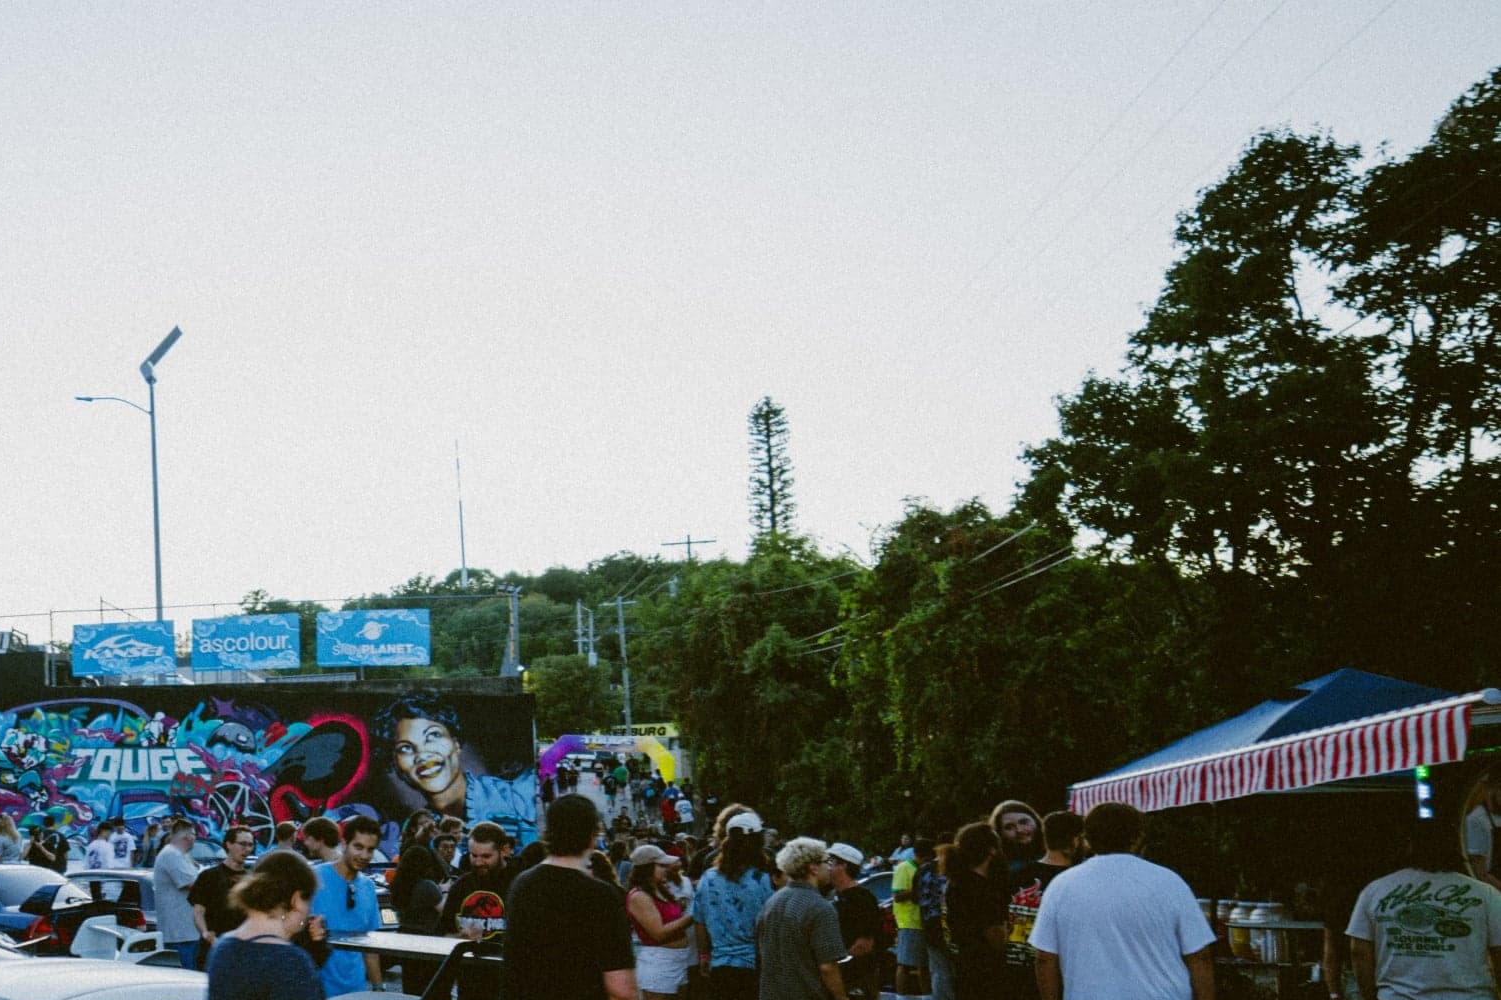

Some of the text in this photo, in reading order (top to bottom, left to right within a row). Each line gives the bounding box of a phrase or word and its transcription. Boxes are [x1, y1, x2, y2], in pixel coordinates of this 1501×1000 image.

[82, 646, 165, 660] KANSEI
[199, 631, 293, 654] ascolour.
[66, 748, 211, 781] TOUGE
